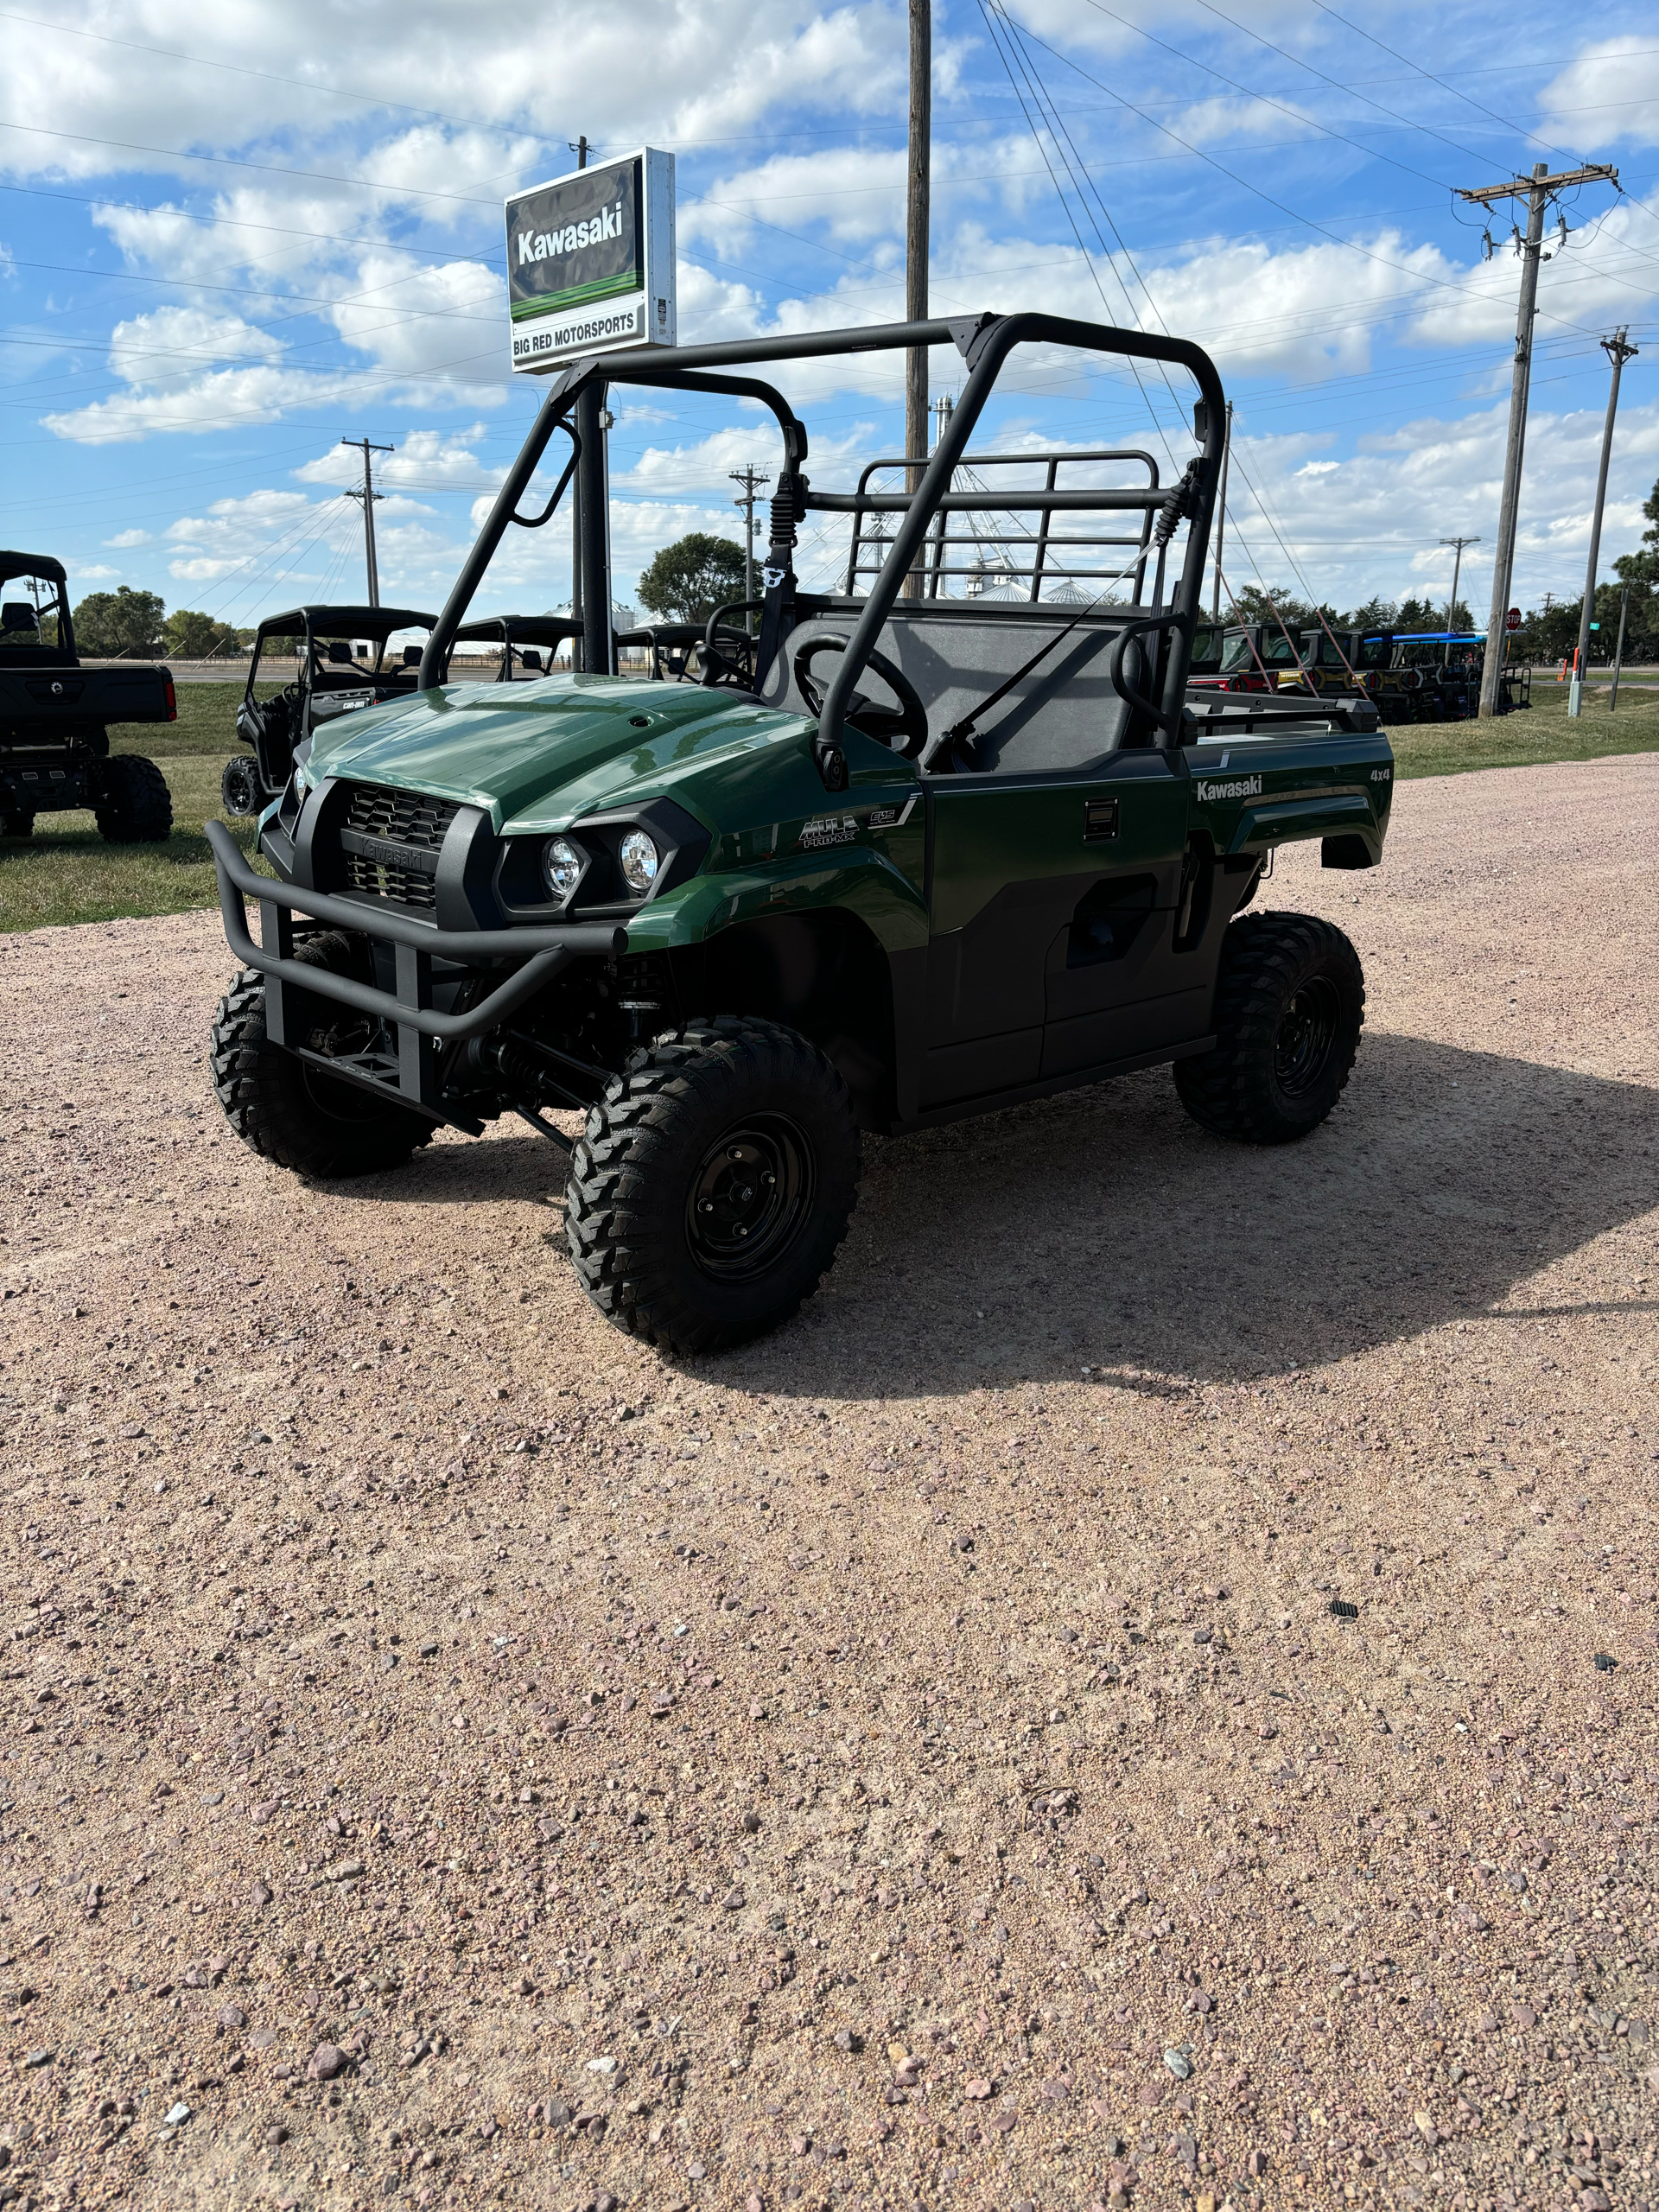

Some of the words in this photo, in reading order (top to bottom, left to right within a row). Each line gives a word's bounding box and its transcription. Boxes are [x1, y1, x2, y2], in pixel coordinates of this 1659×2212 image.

[518, 201, 622, 265] Kawasaki
[514, 338, 530, 355] BIG
[532, 334, 552, 352] RED
[555, 313, 634, 346] MOTORSPORTS
[1507, 614, 1521, 624] STOP
[1197, 774, 1262, 802] Kawasaki
[1370, 768, 1390, 782] 4x4
[799, 816, 860, 841] MULE
[804, 832, 855, 849] PRO-MX
[360, 836, 423, 870] Kawasaki
